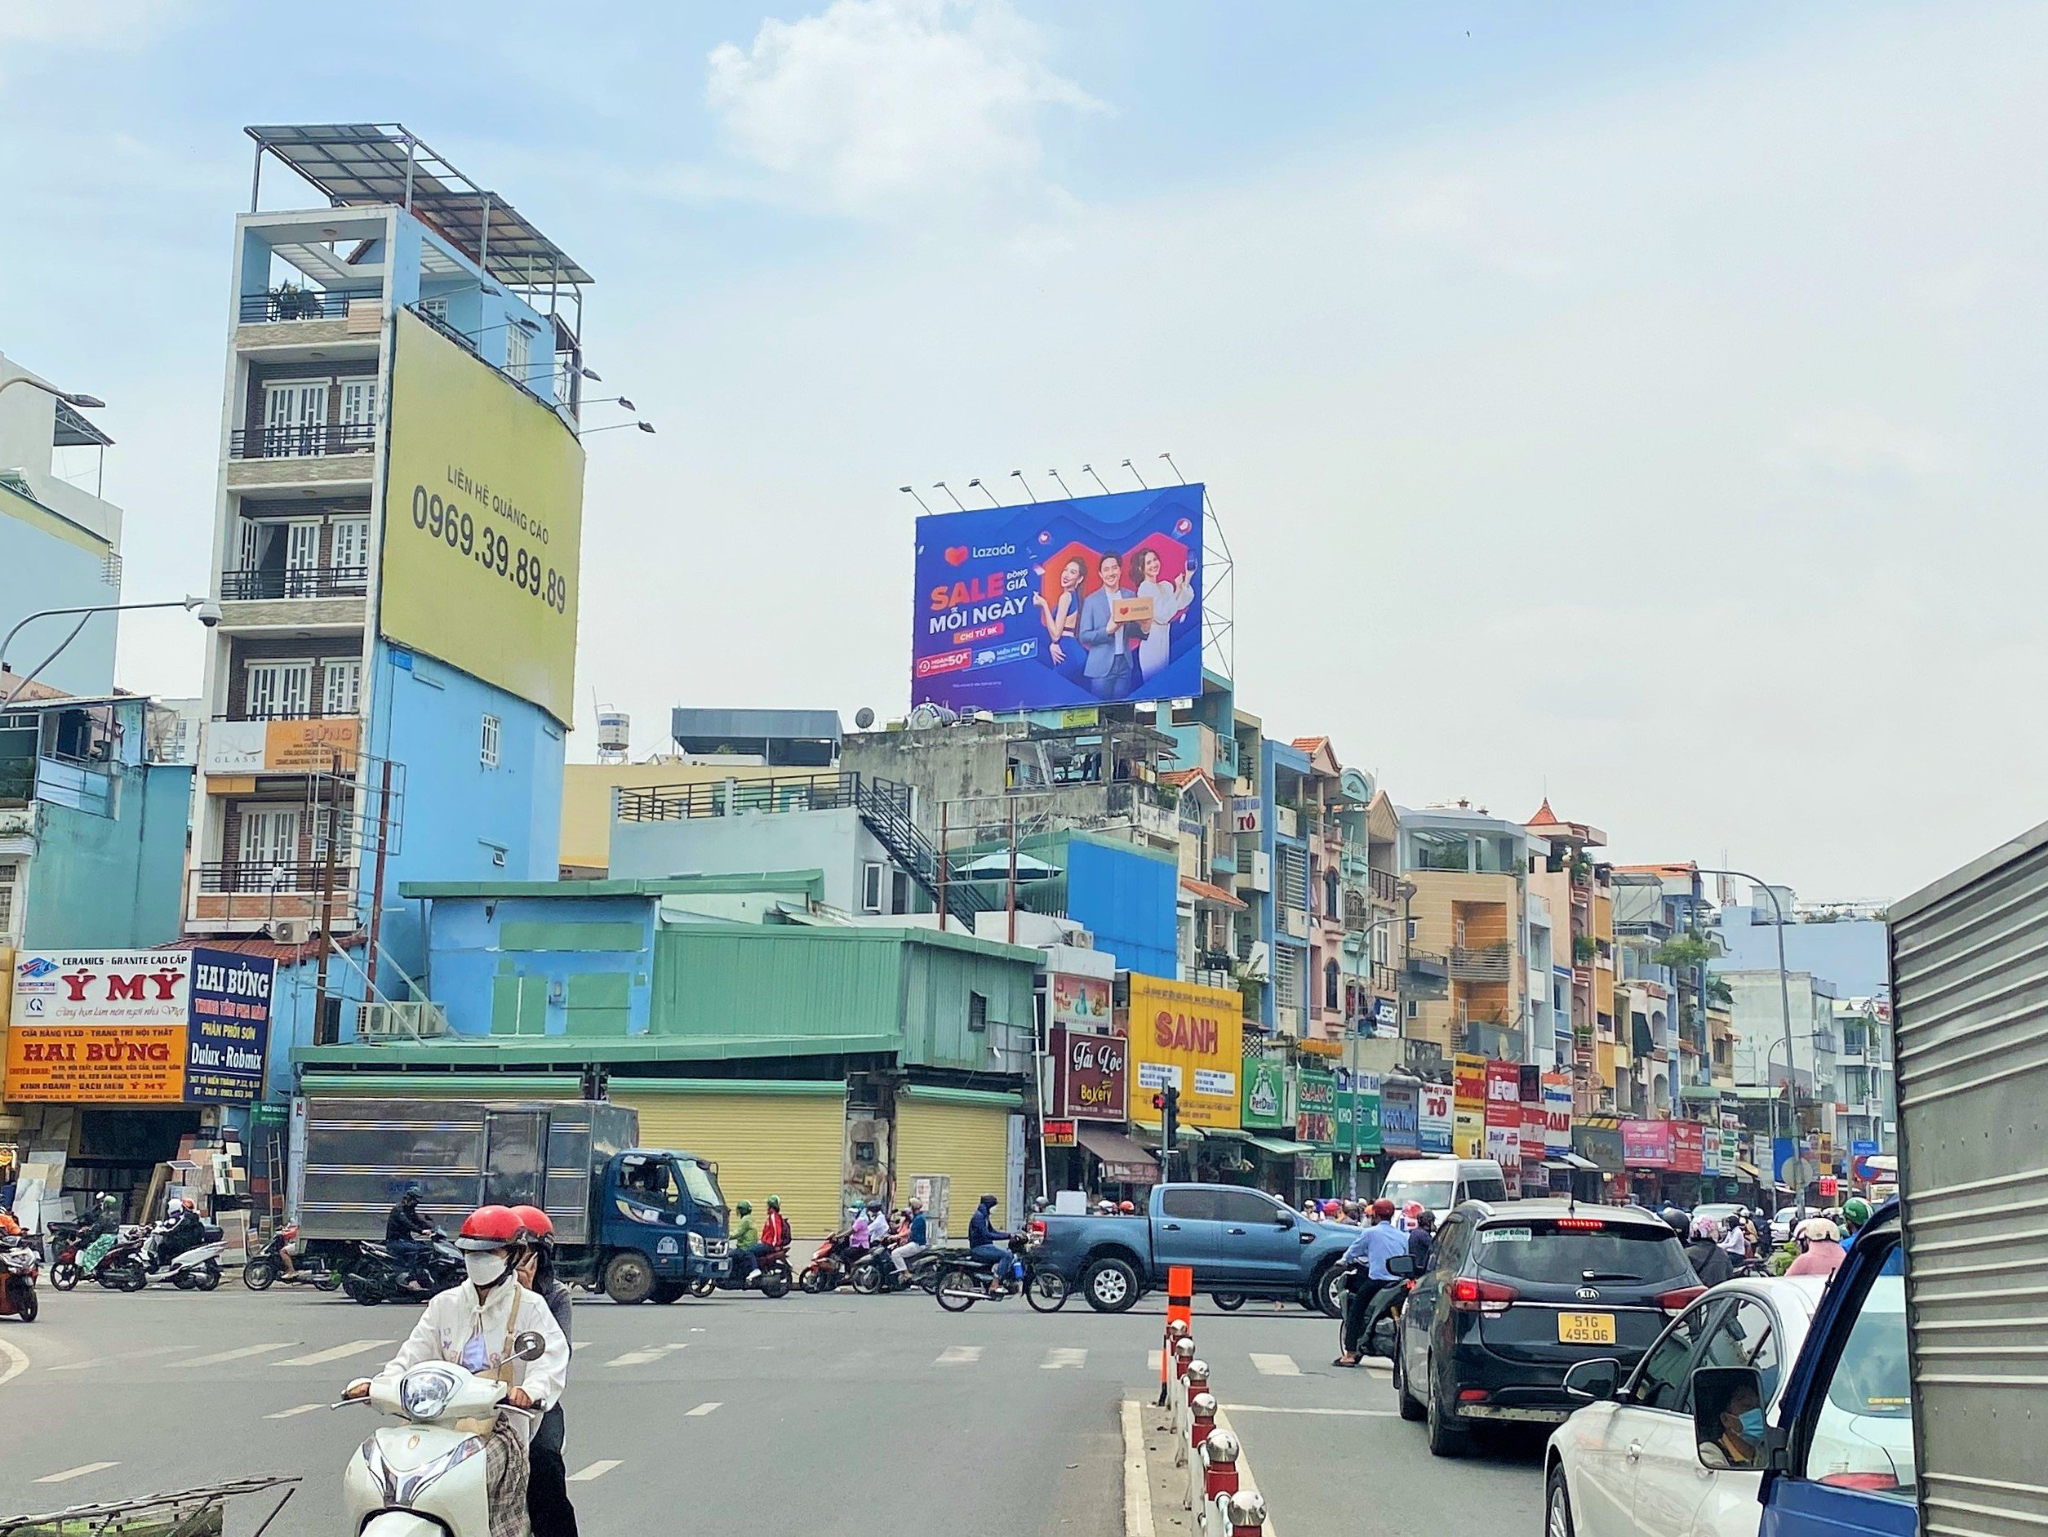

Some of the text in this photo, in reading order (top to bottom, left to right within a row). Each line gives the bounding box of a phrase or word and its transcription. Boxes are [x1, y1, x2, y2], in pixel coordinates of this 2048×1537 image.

[448, 465, 549, 545] LIÊN HỆ QUẢNG CÁO
[413, 485, 566, 614] 0969.39.89.89
[972, 543, 1016, 559] Lazada
[930, 573, 1004, 611] SALE
[930, 596, 1028, 635] MỖI NGÀY
[215, 756, 257, 764] GLASS
[62, 957, 105, 966] CERAMICS
[111, 957, 149, 965] GRANITE
[170, 954, 188, 964] CẤP
[61, 967, 186, 1001] Ý MỸ
[196, 964, 226, 993] HAI
[40, 1029, 61, 1037] HÀNG
[120, 1028, 133, 1036] TRÍ
[1155, 1011, 1218, 1055] SANH
[24, 1043, 77, 1061] HAI
[192, 1042, 221, 1067] Dulux
[226, 1045, 263, 1071] Robmix
[1073, 1041, 1094, 1072] Tài
[1098, 1044, 1123, 1077] Lộc
[1081, 1082, 1113, 1106] Bakery
[1580, 1290, 1596, 1299] KIA
[1566, 1328, 1608, 1341] 495.06
[1575, 1315, 1599, 1328] 51G
